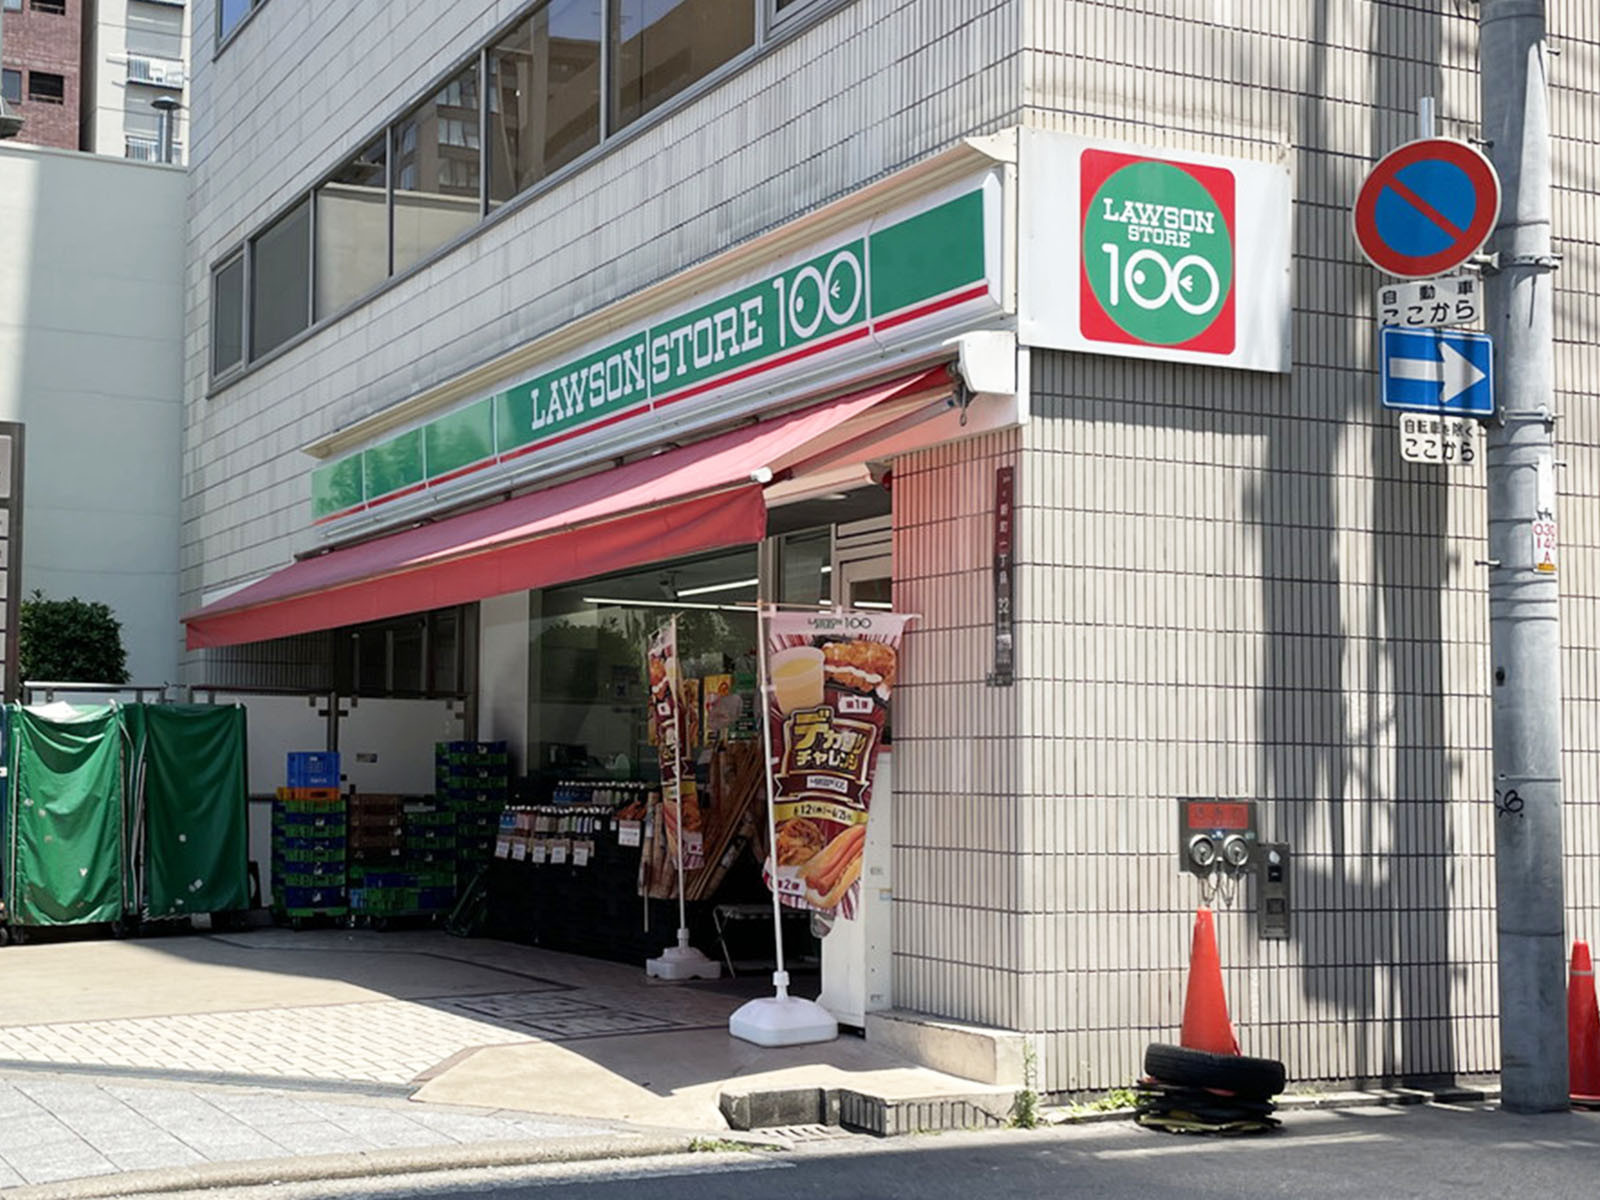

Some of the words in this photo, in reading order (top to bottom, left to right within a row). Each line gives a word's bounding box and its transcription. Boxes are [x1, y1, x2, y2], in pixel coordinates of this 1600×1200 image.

[1103, 197, 1215, 234] LAWSON
[1128, 225, 1191, 248] STORE
[1101, 243, 1220, 315] 100
[1382, 279, 1474, 305] 自動車
[1382, 299, 1475, 327] ここから
[531, 344, 646, 430] LAWSON
[652, 296, 763, 384] STORE
[773, 251, 863, 348] 100
[1404, 438, 1475, 462] ここから
